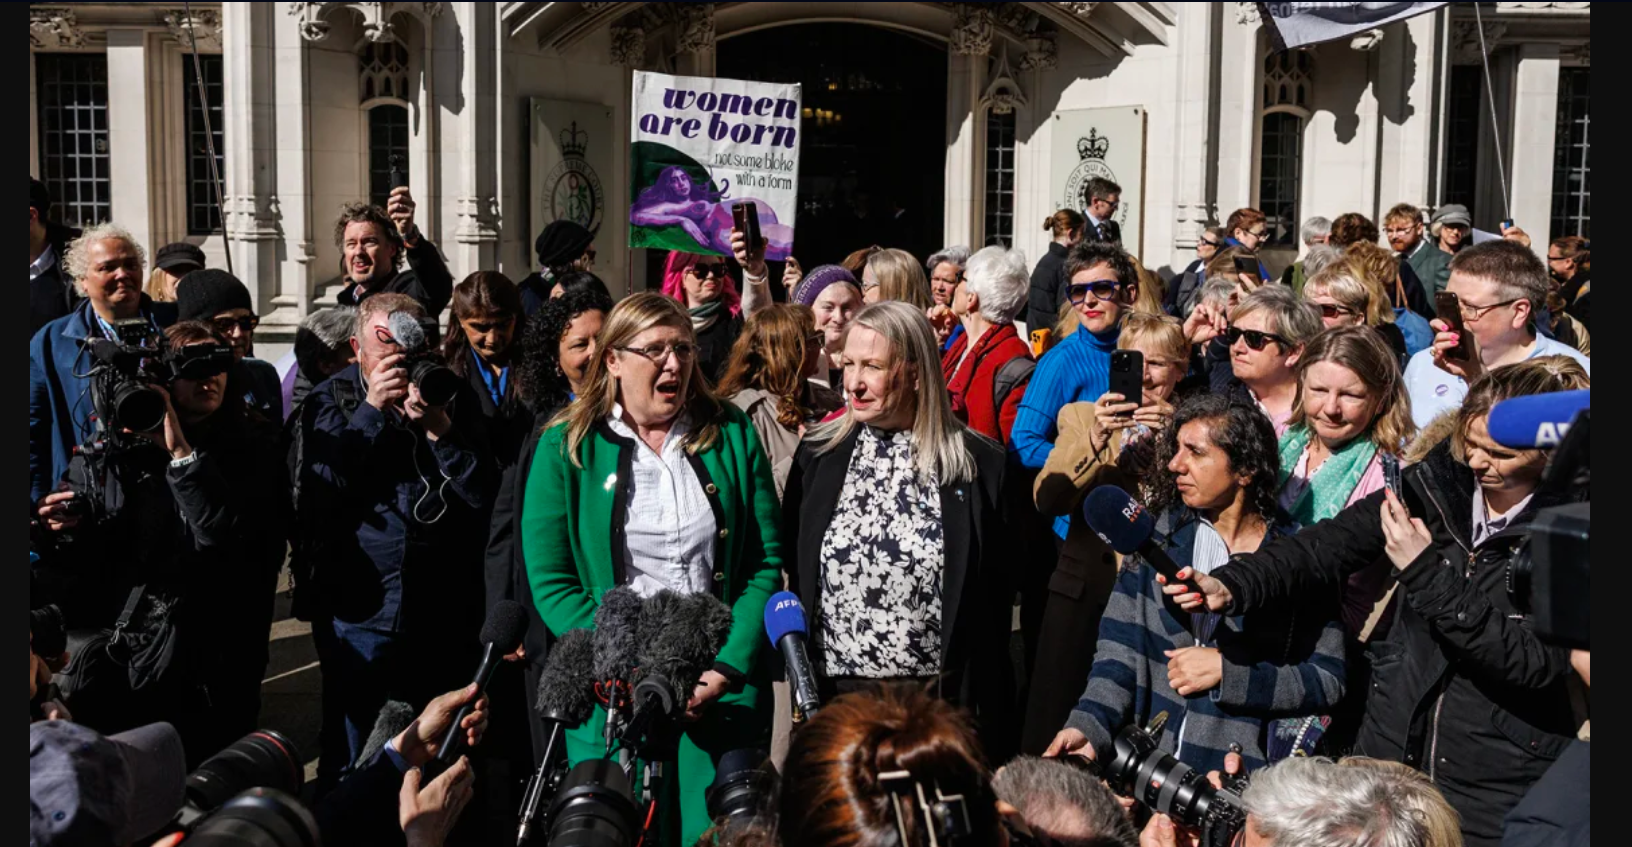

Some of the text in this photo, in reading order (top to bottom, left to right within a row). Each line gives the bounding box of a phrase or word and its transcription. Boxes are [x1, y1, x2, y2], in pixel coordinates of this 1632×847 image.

[662, 87, 798, 120] women
[639, 112, 797, 149] are born
[714, 152, 794, 172] not some bloke
[735, 171, 792, 190] with a form
[1069, 170, 1083, 188] SOIT
[1084, 164, 1098, 174] QUI
[775, 599, 798, 612] AFP
